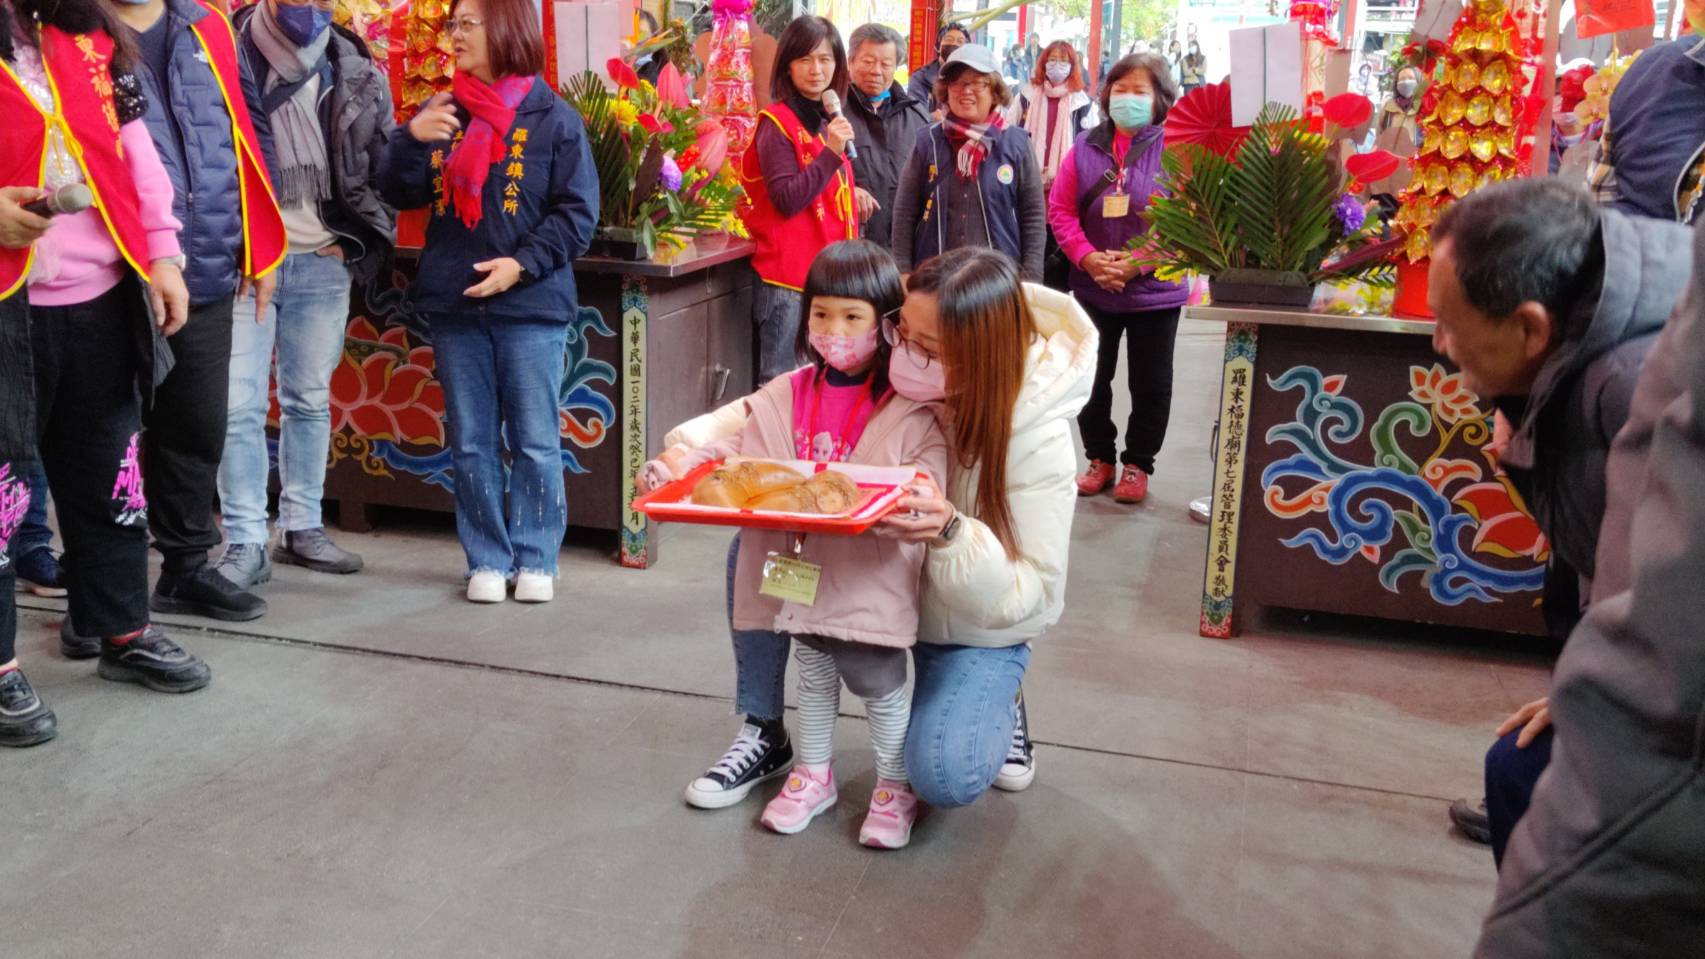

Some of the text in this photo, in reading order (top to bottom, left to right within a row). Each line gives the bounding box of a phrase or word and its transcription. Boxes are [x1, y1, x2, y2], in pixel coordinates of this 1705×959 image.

[502, 127, 529, 216] 羅東鎮公所
